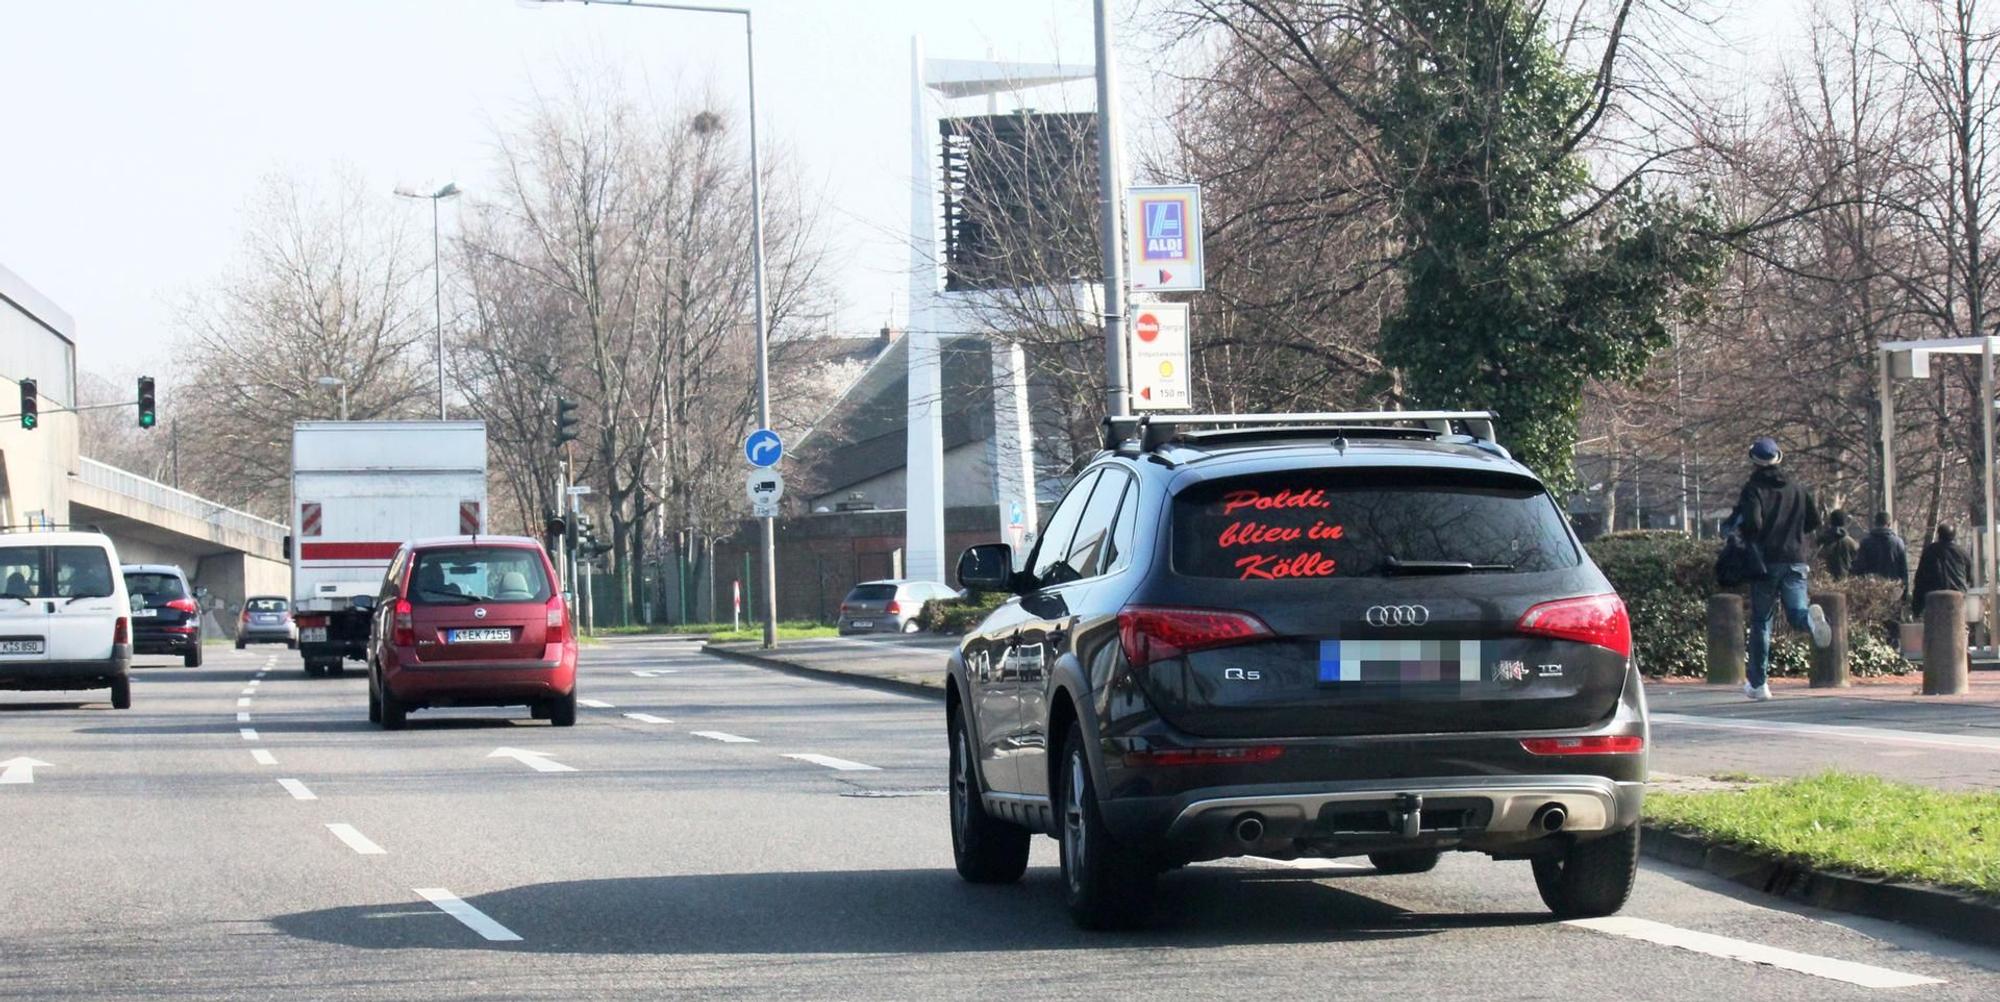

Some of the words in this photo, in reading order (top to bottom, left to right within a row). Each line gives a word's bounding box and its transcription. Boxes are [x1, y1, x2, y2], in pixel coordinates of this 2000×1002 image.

[1148, 238, 1182, 251] ALDI
[1160, 389, 1175, 398] 150
[1308, 521, 1343, 539] in
[1235, 551, 1335, 580] Kölle
[1225, 668, 1260, 680] Q5
[1539, 664, 1562, 672] TDI
